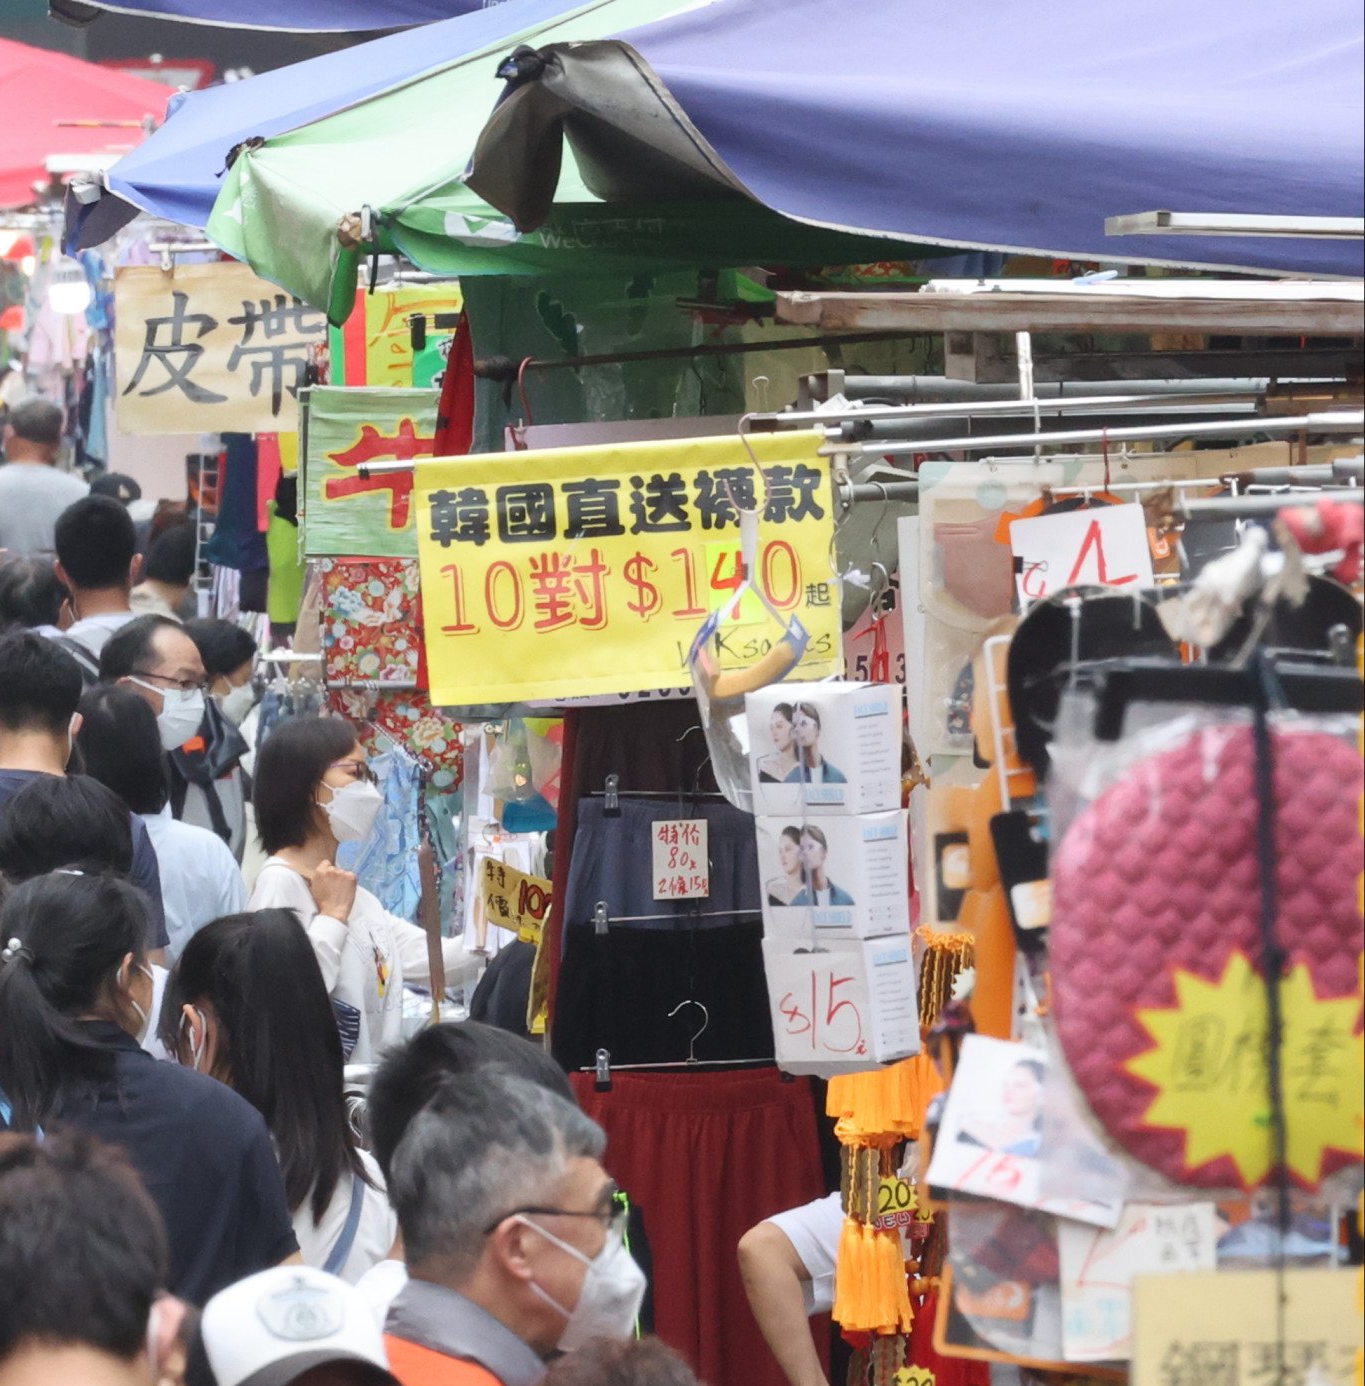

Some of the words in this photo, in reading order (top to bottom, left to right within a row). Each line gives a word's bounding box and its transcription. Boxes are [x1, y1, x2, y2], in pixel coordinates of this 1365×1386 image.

[121, 290, 327, 418] 皮帶
[428, 463, 825, 548] 韓國直送襪款
